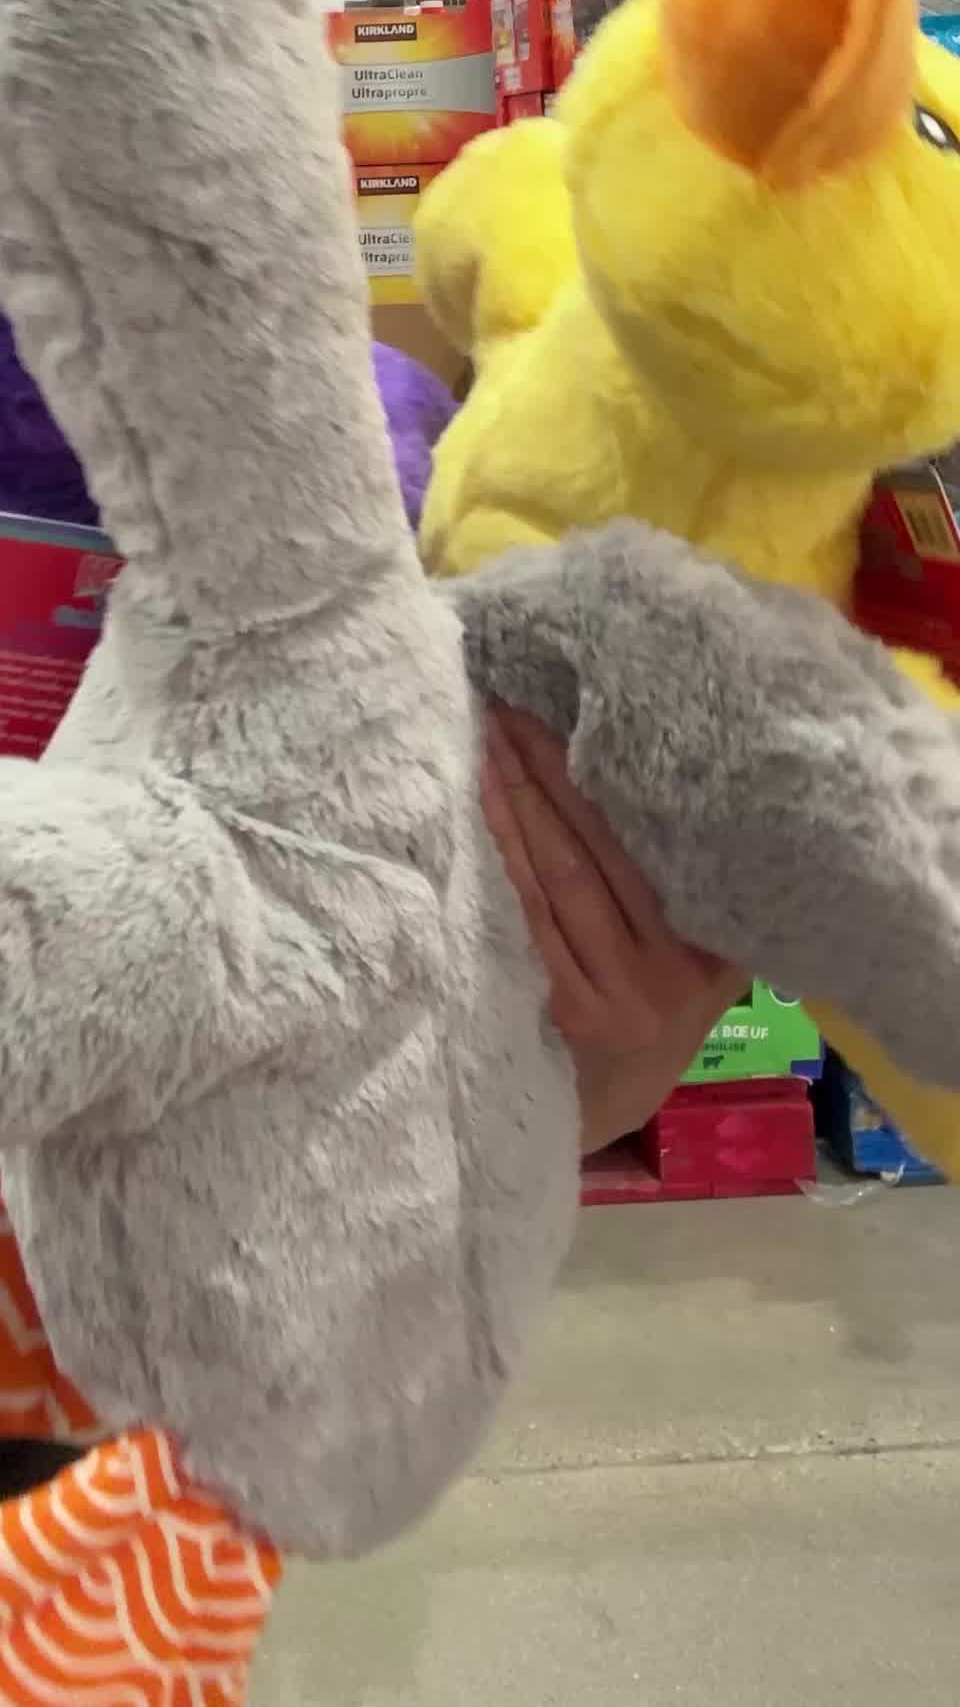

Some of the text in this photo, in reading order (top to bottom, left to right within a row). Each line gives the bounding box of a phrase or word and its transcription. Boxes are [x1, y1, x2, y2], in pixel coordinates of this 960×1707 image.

[357, 24, 416, 37] KIRKLAND
[354, 68, 423, 81] UltraClean
[351, 87, 428, 100] Ultrapropre
[360, 177, 418, 189] KIRKLAND
[358, 233, 412, 245] UltraCle
